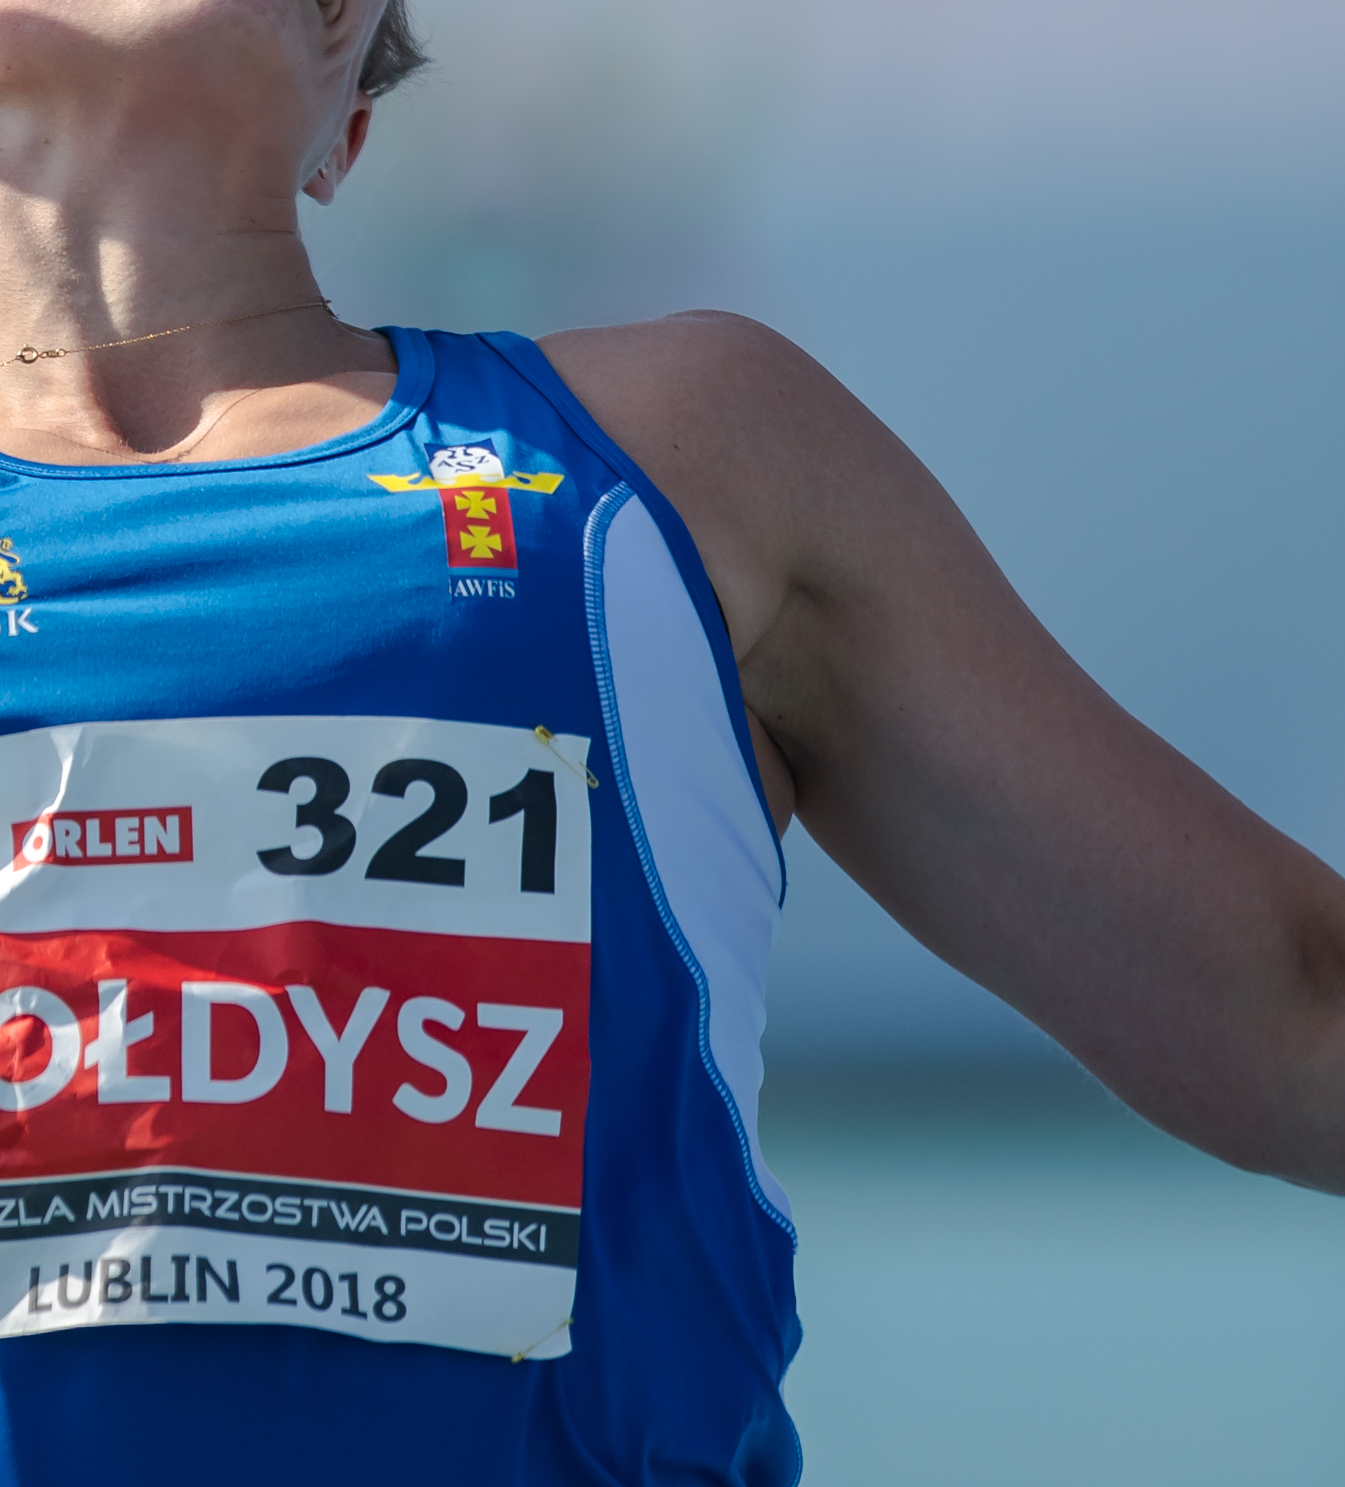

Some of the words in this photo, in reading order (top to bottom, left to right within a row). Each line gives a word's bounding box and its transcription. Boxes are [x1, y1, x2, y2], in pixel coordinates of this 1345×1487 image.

[22, 815, 181, 862] ORLEN
[257, 757, 557, 895] 321
[86, 1185, 389, 1235] MISTRZOSTWA
[400, 1209, 547, 1252] POLSKI
[27, 1254, 241, 1315] LUBLIN
[266, 1263, 407, 1323] 2018
